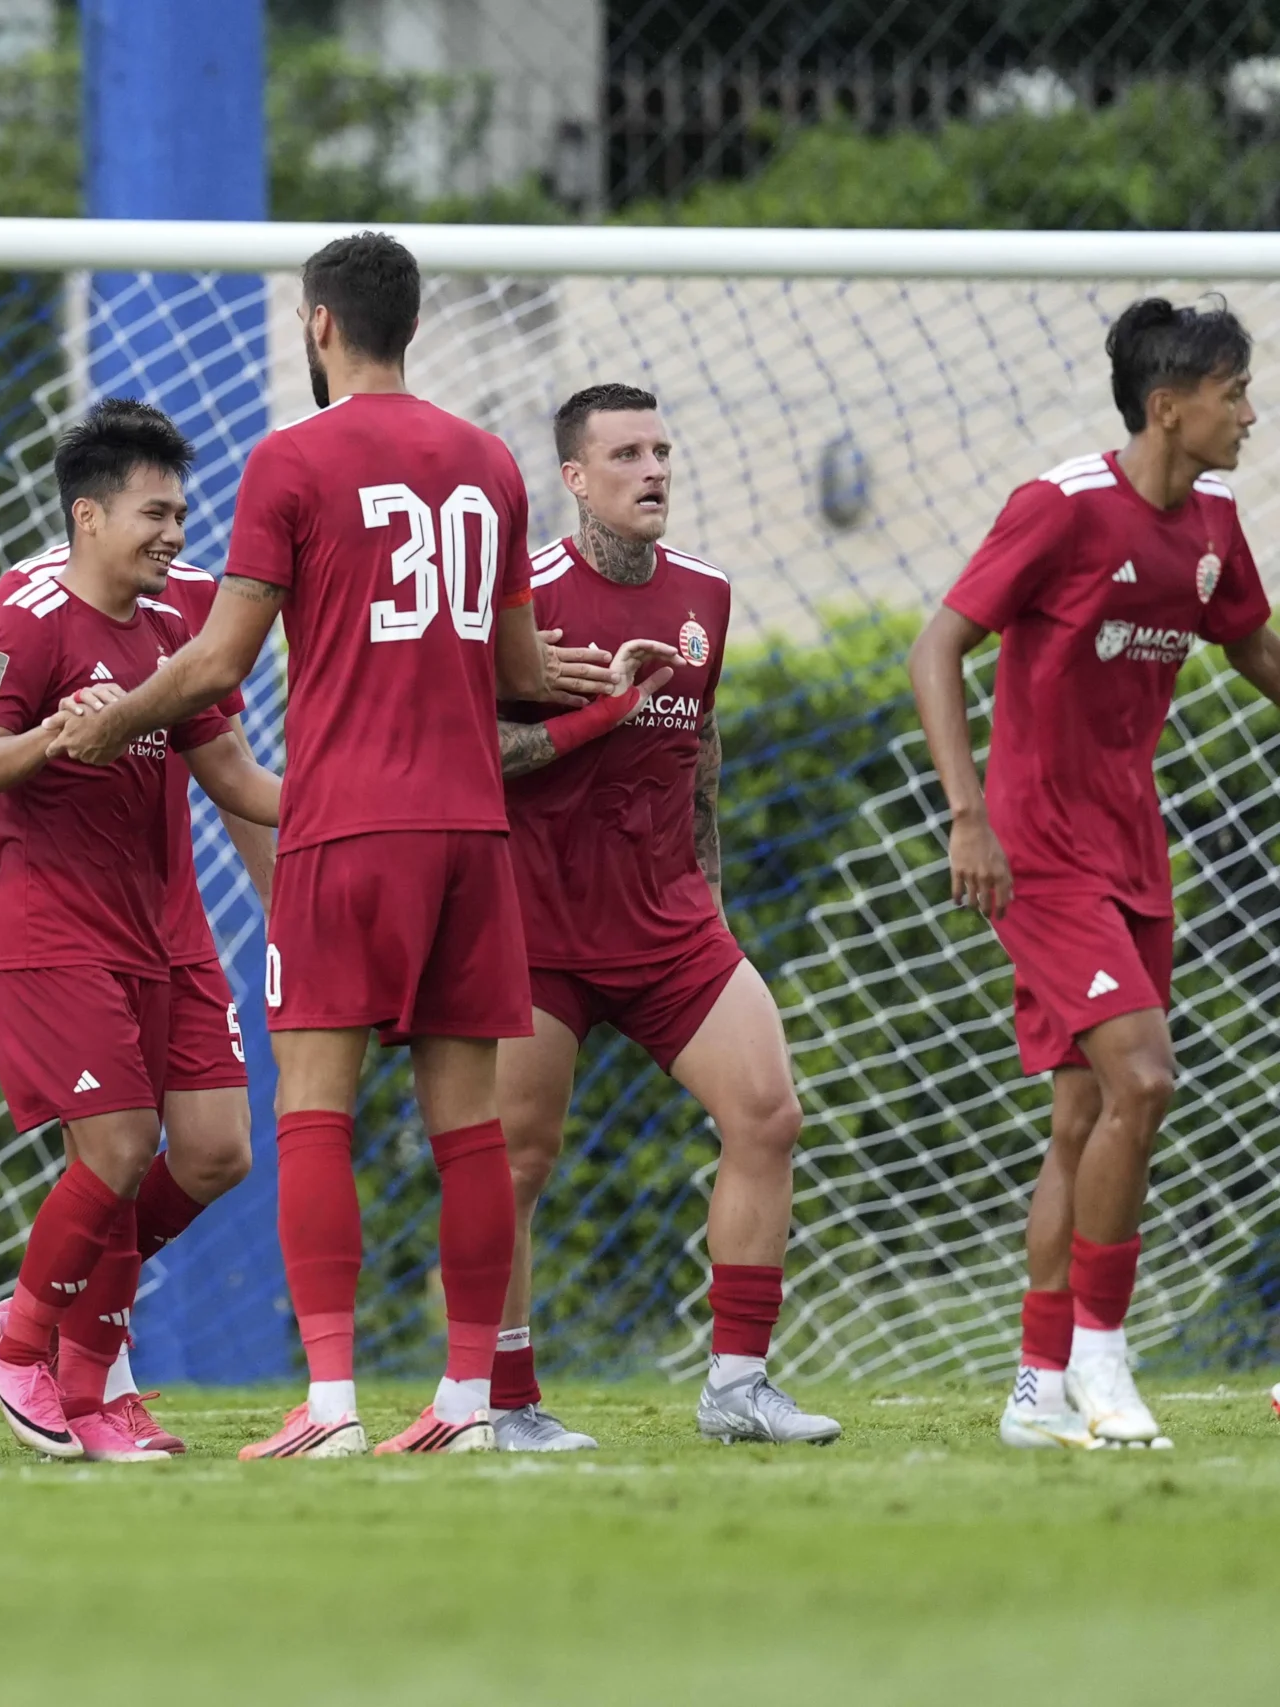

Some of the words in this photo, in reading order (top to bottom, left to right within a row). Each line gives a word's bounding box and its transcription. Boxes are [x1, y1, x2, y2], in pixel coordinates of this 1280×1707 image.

[357, 482, 499, 644] 30
[640, 694, 700, 717] ACAN
[624, 715, 697, 731] MAYORAN
